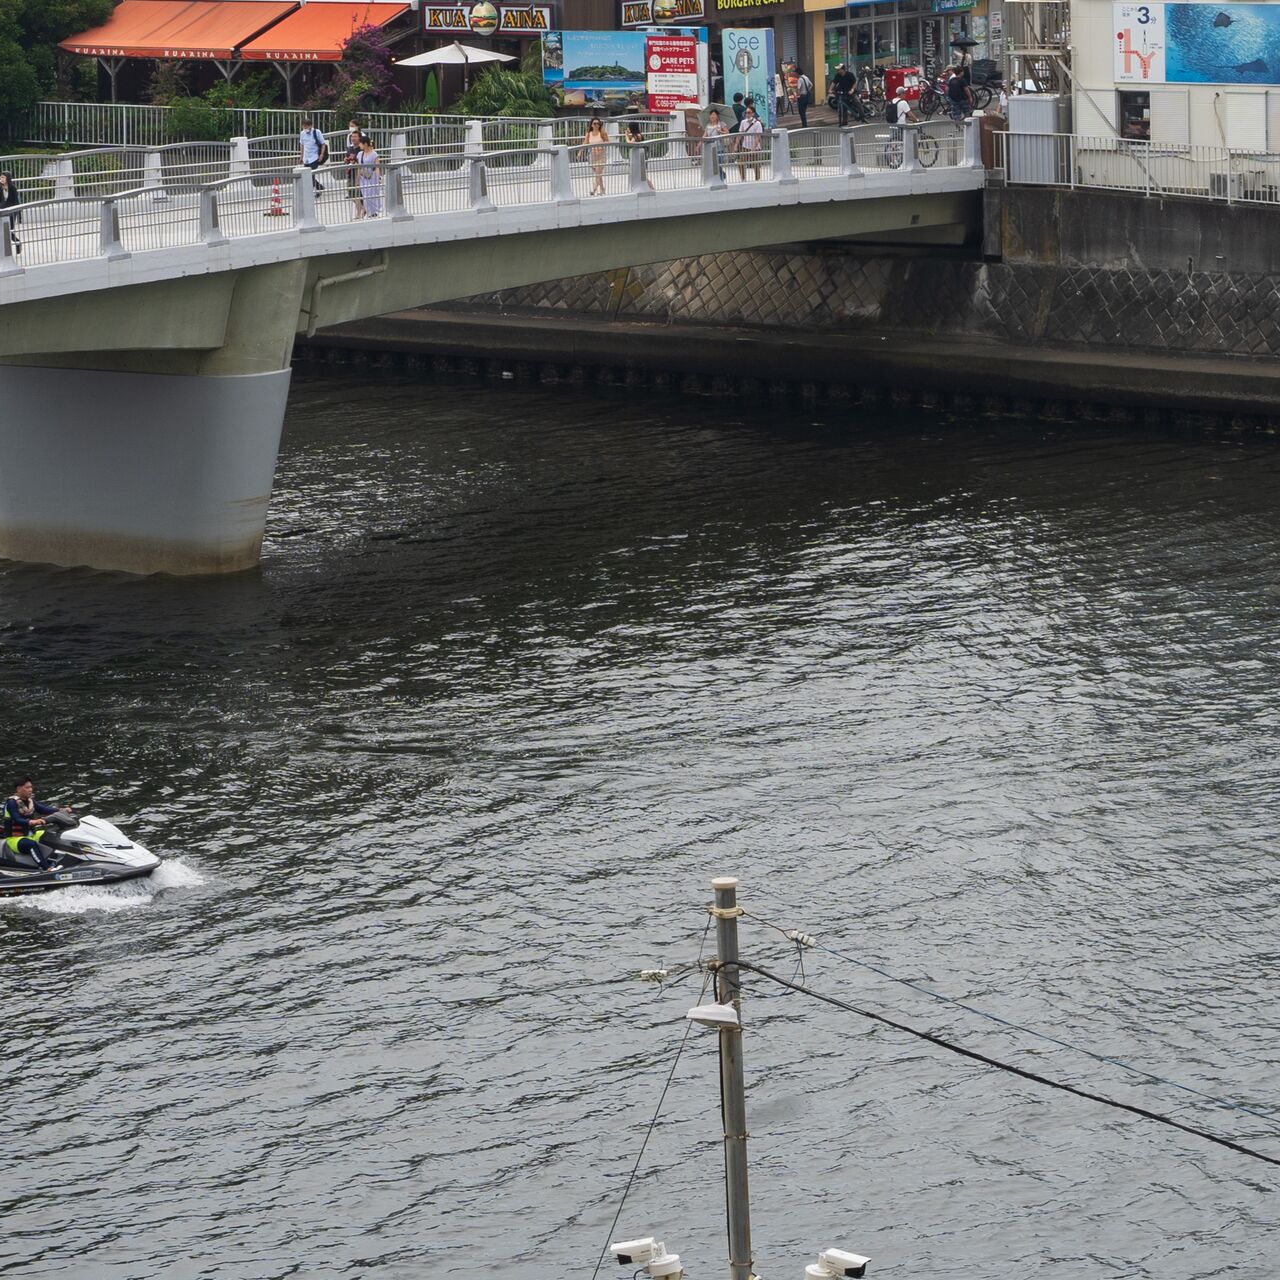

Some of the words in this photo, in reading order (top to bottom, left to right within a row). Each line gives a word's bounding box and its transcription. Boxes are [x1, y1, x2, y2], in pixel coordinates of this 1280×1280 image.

[428, 8, 467, 27] KUA
[623, 2, 651, 24] KUA
[729, 32, 760, 51] See
[729, 55, 760, 73] yu
